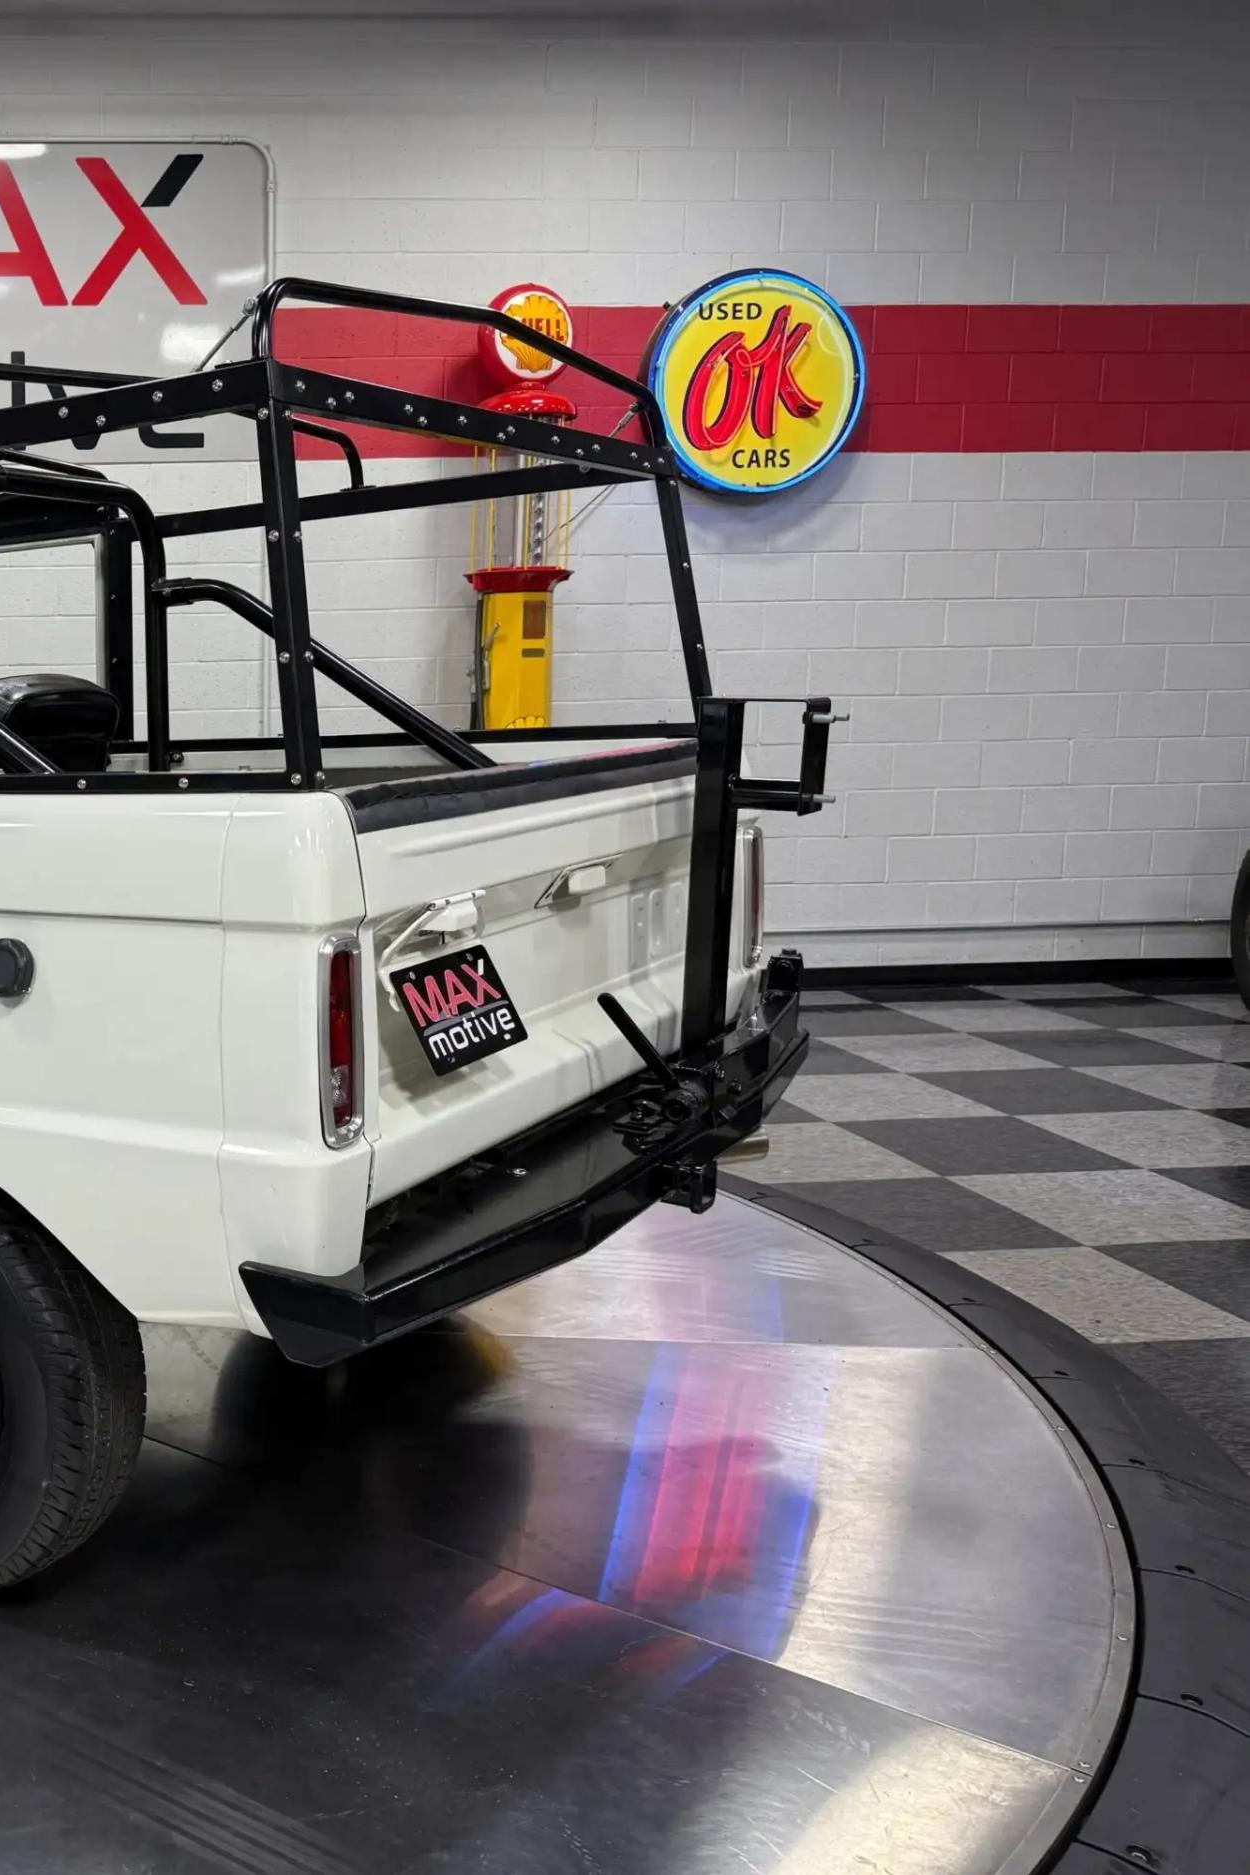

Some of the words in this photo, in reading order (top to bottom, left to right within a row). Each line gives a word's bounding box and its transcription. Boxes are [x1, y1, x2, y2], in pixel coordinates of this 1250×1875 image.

[700, 302, 762, 320] USED
[682, 305, 823, 451] OK
[732, 449, 790, 468] CARS
[402, 958, 501, 1027] MAX
[428, 1008, 516, 1059] motive
